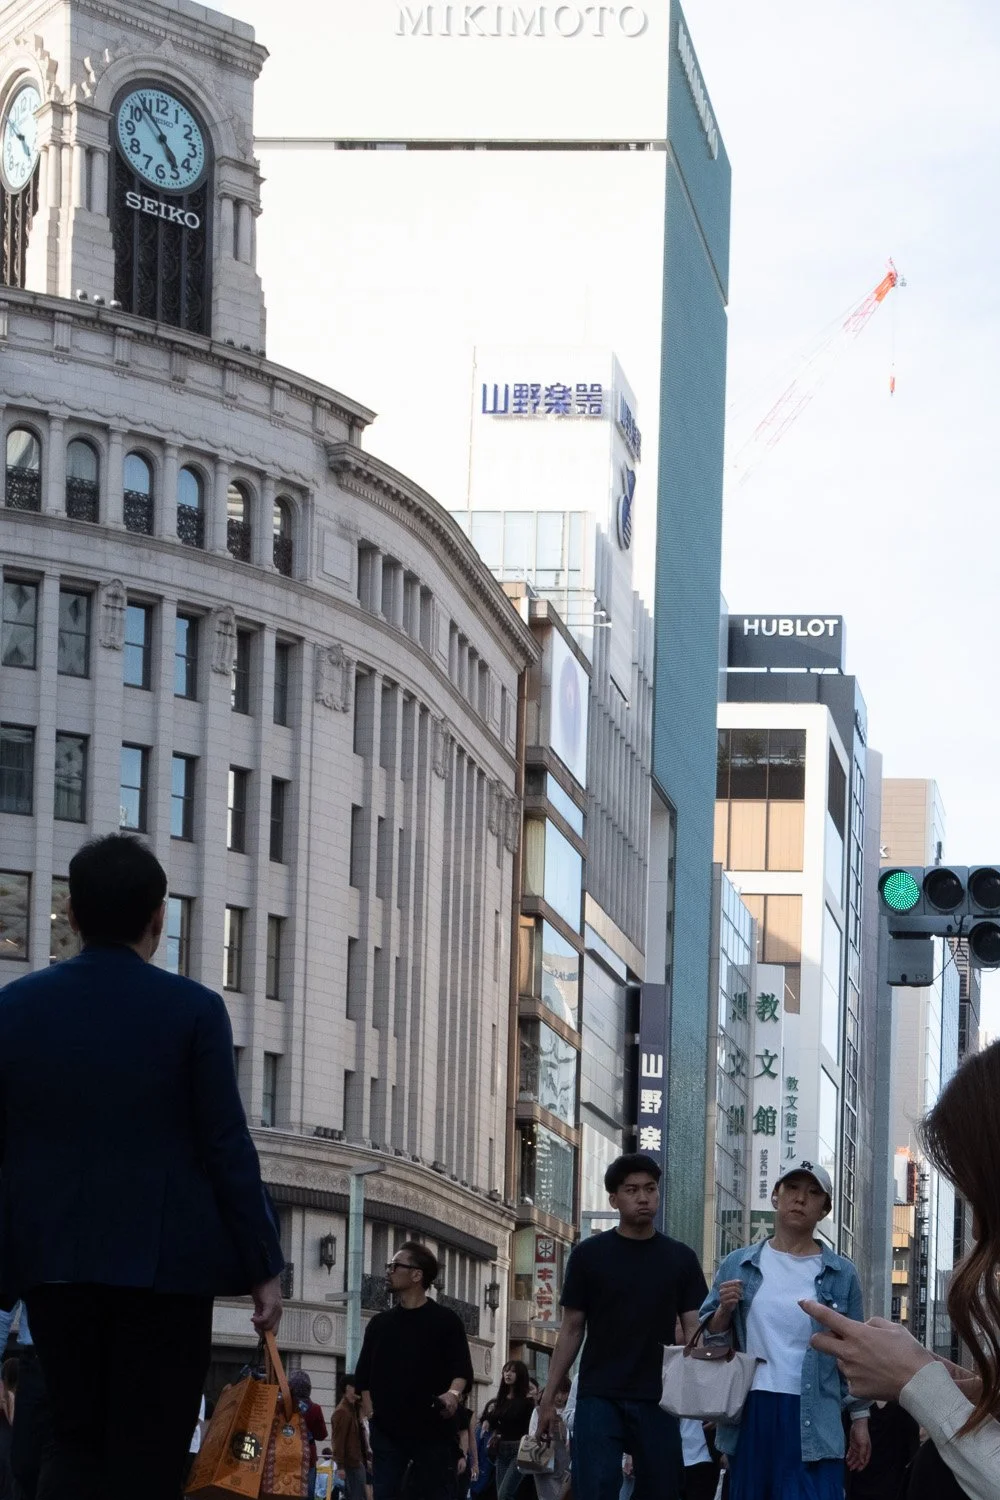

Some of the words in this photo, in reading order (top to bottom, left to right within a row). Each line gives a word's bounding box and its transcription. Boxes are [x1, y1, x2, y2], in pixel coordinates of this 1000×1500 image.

[394, 5, 649, 39] MIKIMOTO
[129, 105, 143, 122] 10
[155, 98, 170, 116] 12
[125, 191, 201, 229] SEIKO
[481, 382, 603, 415] 山野楽器
[743, 618, 839, 637] HUBLOT
[752, 992, 780, 1137] 教文館
[639, 1053, 664, 1151] 山野楽
[784, 1075, 800, 1160] 教文館ビル
[760, 1149, 768, 1176] SINCE
